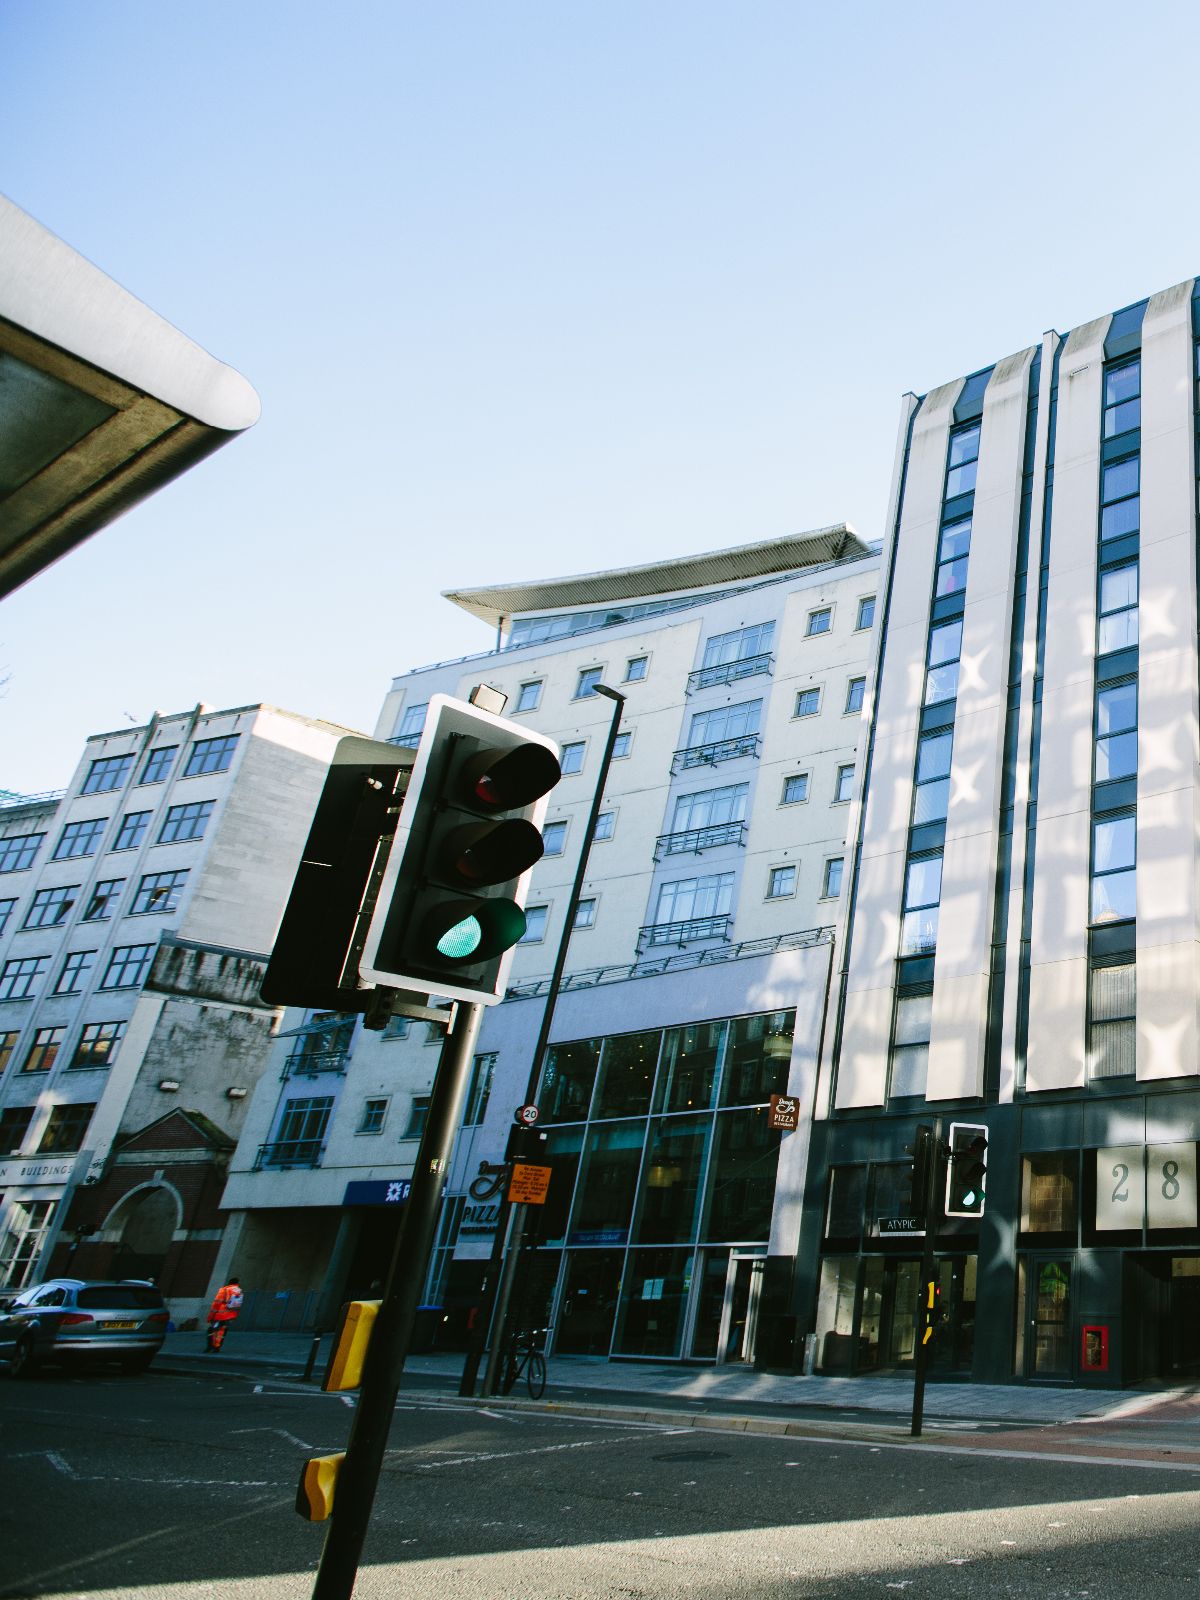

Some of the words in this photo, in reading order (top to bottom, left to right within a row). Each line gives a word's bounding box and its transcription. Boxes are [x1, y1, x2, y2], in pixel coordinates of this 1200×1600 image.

[524, 1109, 537, 1118] 20
[774, 1114, 794, 1123] PIZZA
[20, 1166, 73, 1176] BUILDINGS
[887, 1219, 917, 1229] ATYPIC
